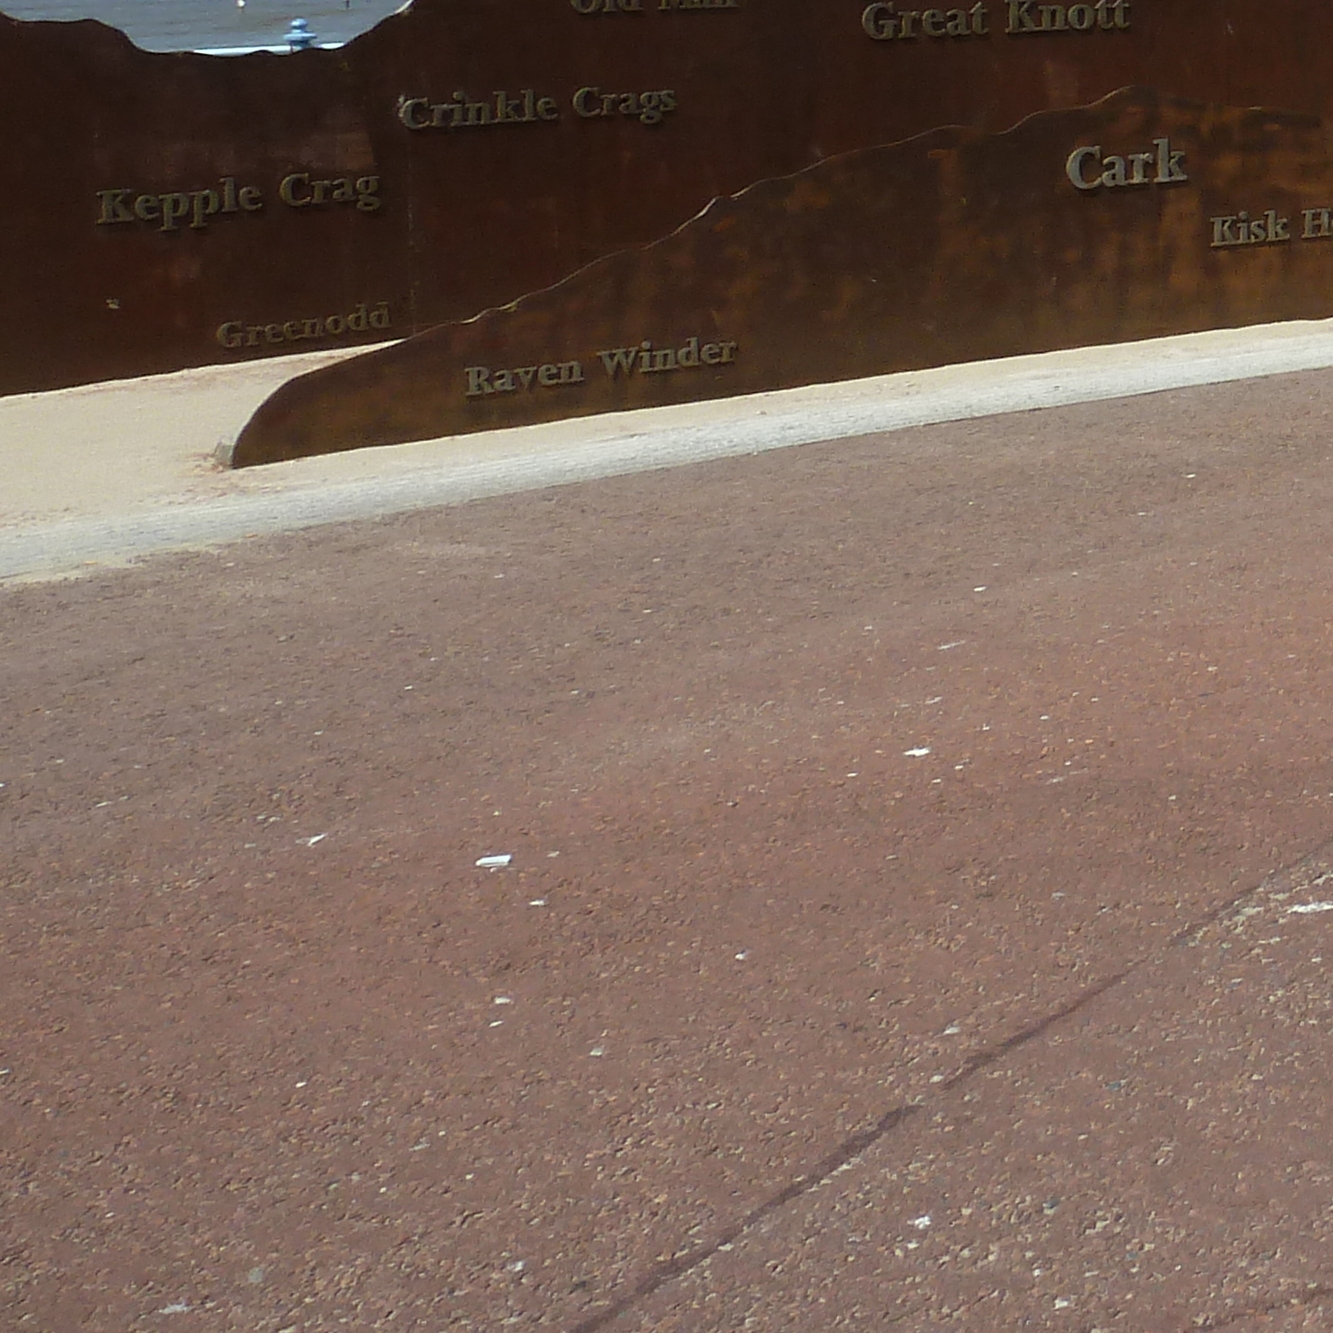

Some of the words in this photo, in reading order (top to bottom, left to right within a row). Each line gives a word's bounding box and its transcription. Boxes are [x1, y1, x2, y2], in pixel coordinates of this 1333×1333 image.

[862, 1, 989, 40] Great
[402, 89, 559, 130] Crinkle
[573, 87, 677, 124] Crags
[1066, 136, 1188, 189] Cark
[96, 177, 262, 231] Kepple
[280, 173, 380, 211] Crag
[1210, 209, 1290, 247] Kisk
[216, 301, 391, 348] Greenodd
[464, 360, 585, 397] Raven
[597, 337, 738, 376] Winder
